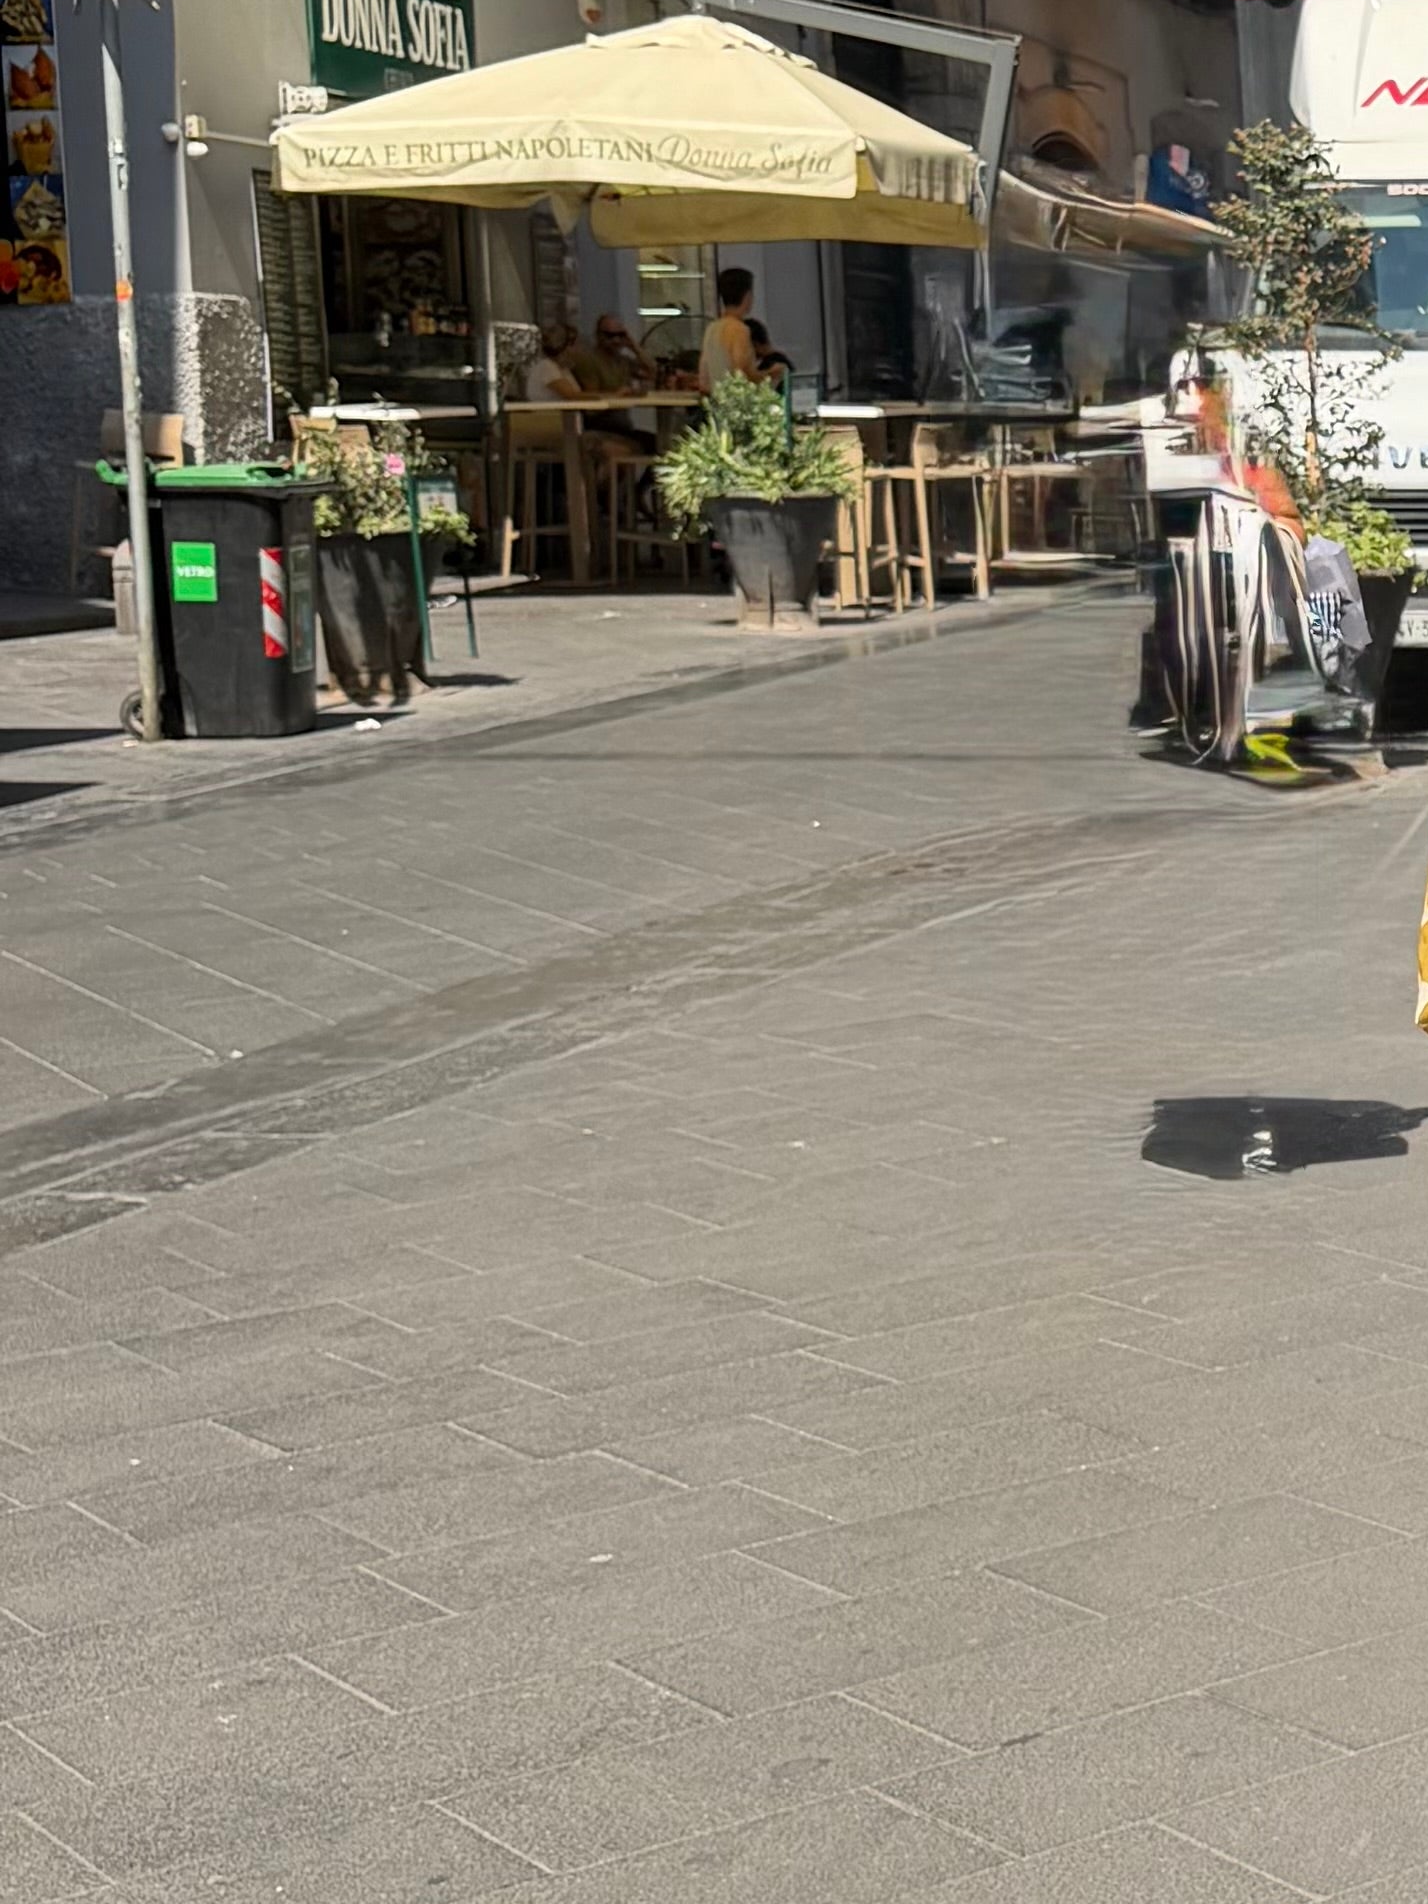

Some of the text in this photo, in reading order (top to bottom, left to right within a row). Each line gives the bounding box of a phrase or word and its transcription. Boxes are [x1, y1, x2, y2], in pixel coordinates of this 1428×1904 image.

[303, 133, 833, 178] PIZZA E FRITTI NAPOLETANI Donna Sofia
